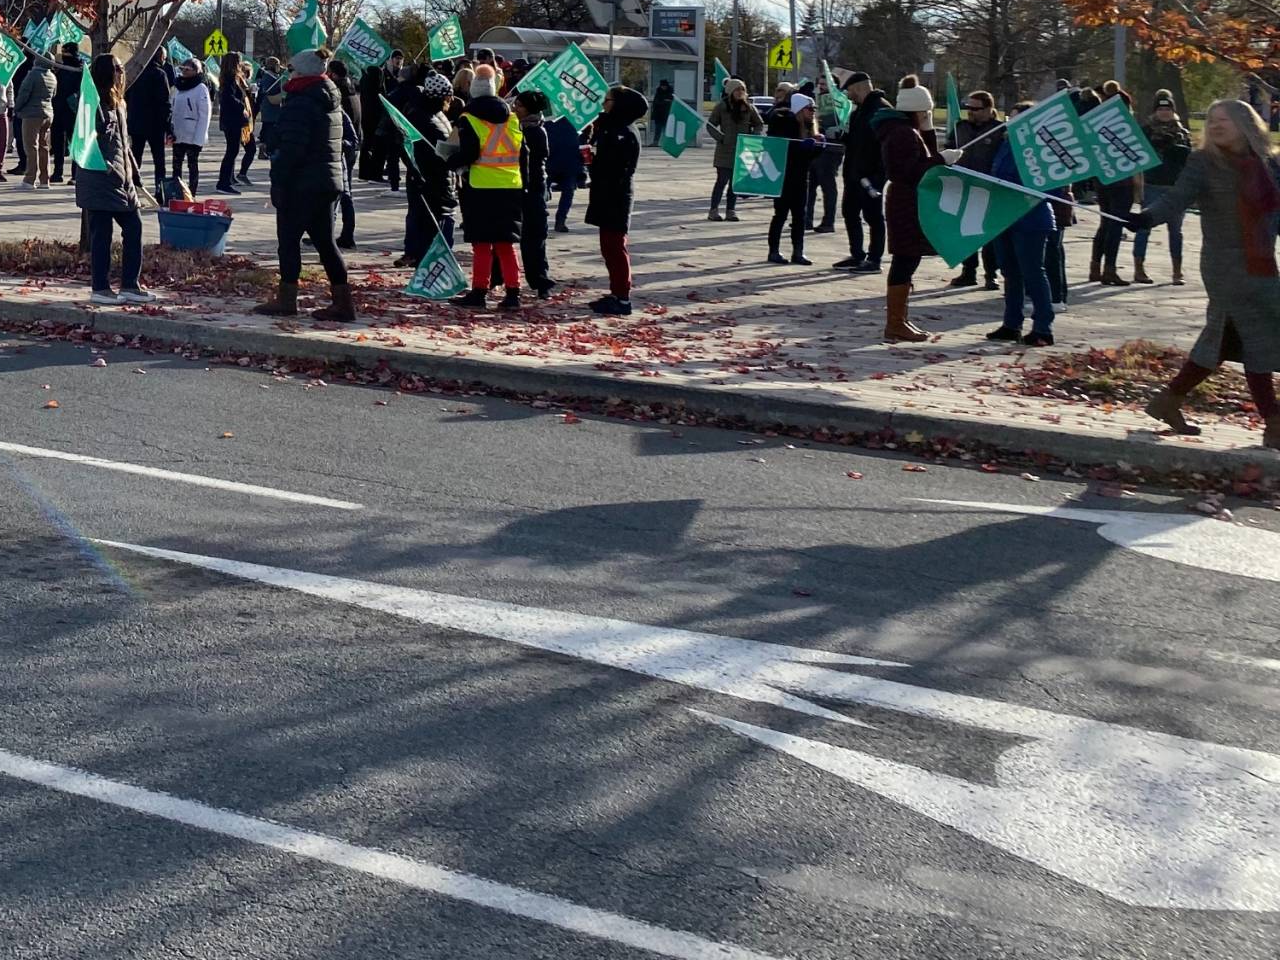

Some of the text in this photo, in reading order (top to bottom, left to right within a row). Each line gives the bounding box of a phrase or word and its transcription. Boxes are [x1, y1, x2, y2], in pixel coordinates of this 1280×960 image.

[547, 48, 607, 114] NOUS
[1029, 103, 1090, 181] NOUS
[1088, 106, 1150, 172] NOUS
